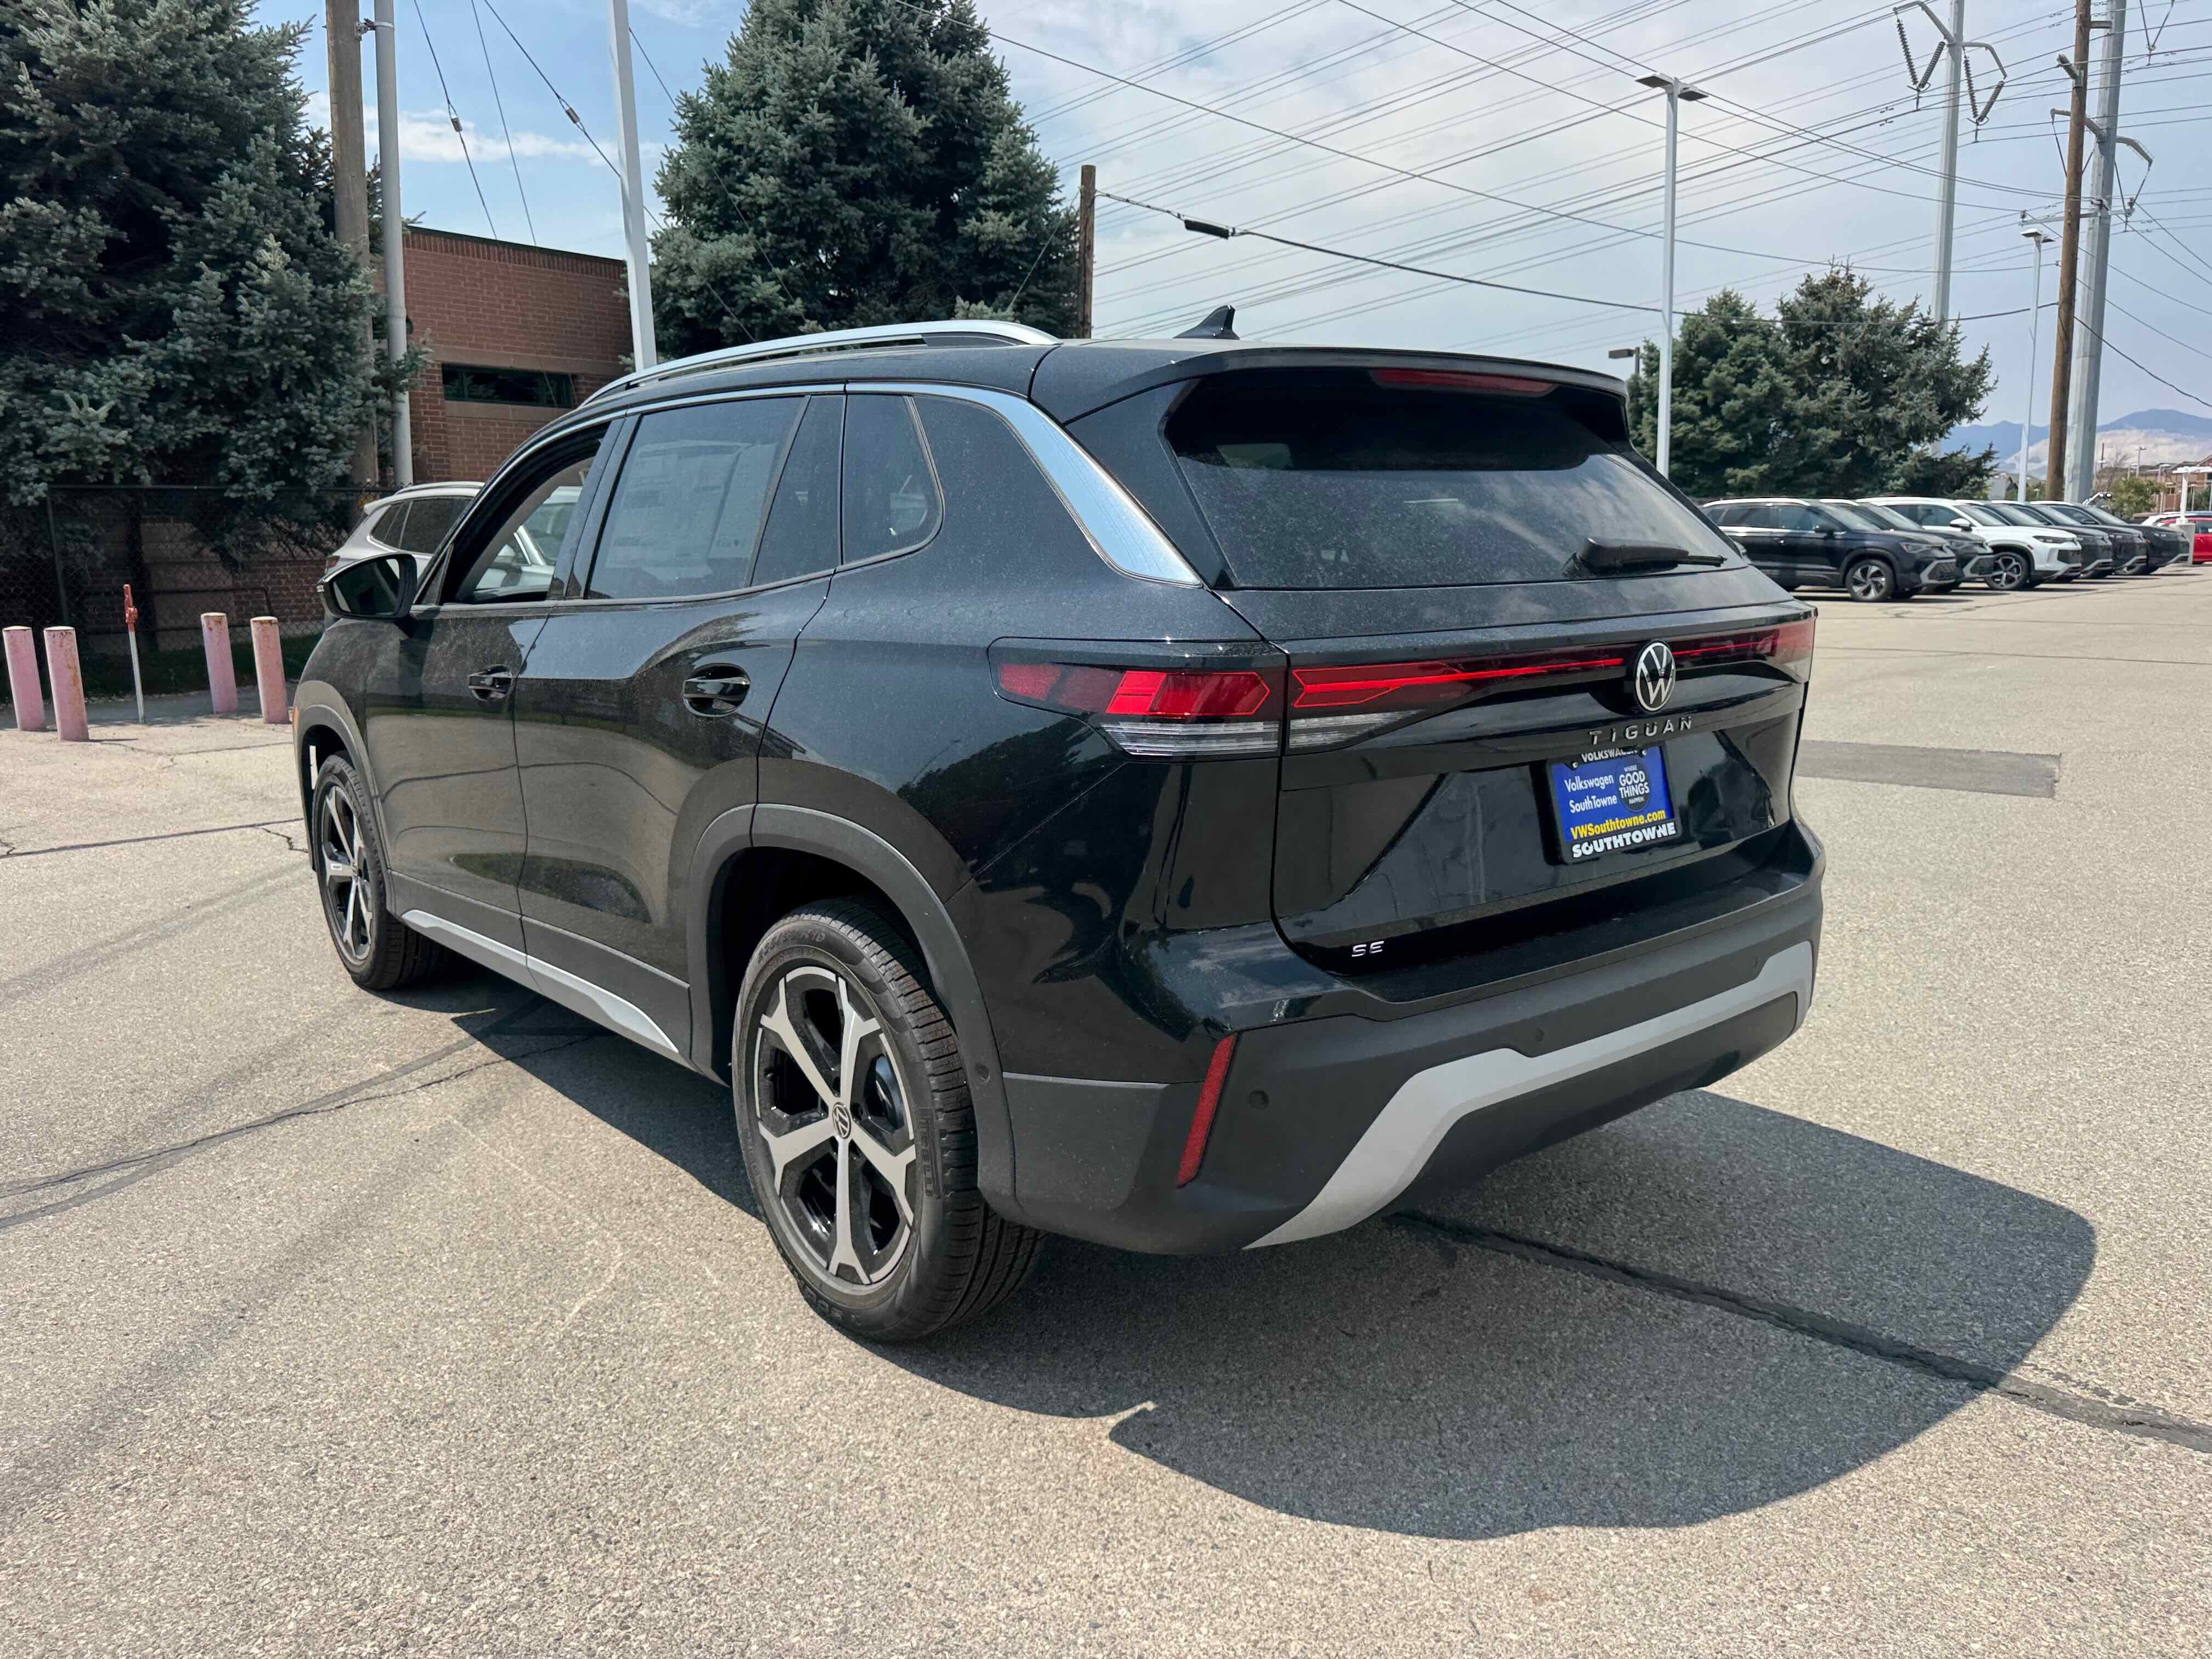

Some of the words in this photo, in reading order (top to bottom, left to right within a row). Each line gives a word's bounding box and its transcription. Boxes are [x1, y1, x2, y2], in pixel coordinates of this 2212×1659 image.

[1589, 716, 1692, 744] TIGUAN
[1564, 774, 1614, 793] Volkswagen
[1619, 771, 1645, 786] GOOD
[1618, 782, 1650, 798] THINGS
[1569, 795, 1617, 813] SouthTowne
[1570, 809, 1666, 839] VWSouthtowne.com
[1572, 822, 1677, 857] SOUTHTOWNE
[1351, 940, 1385, 957] SE
